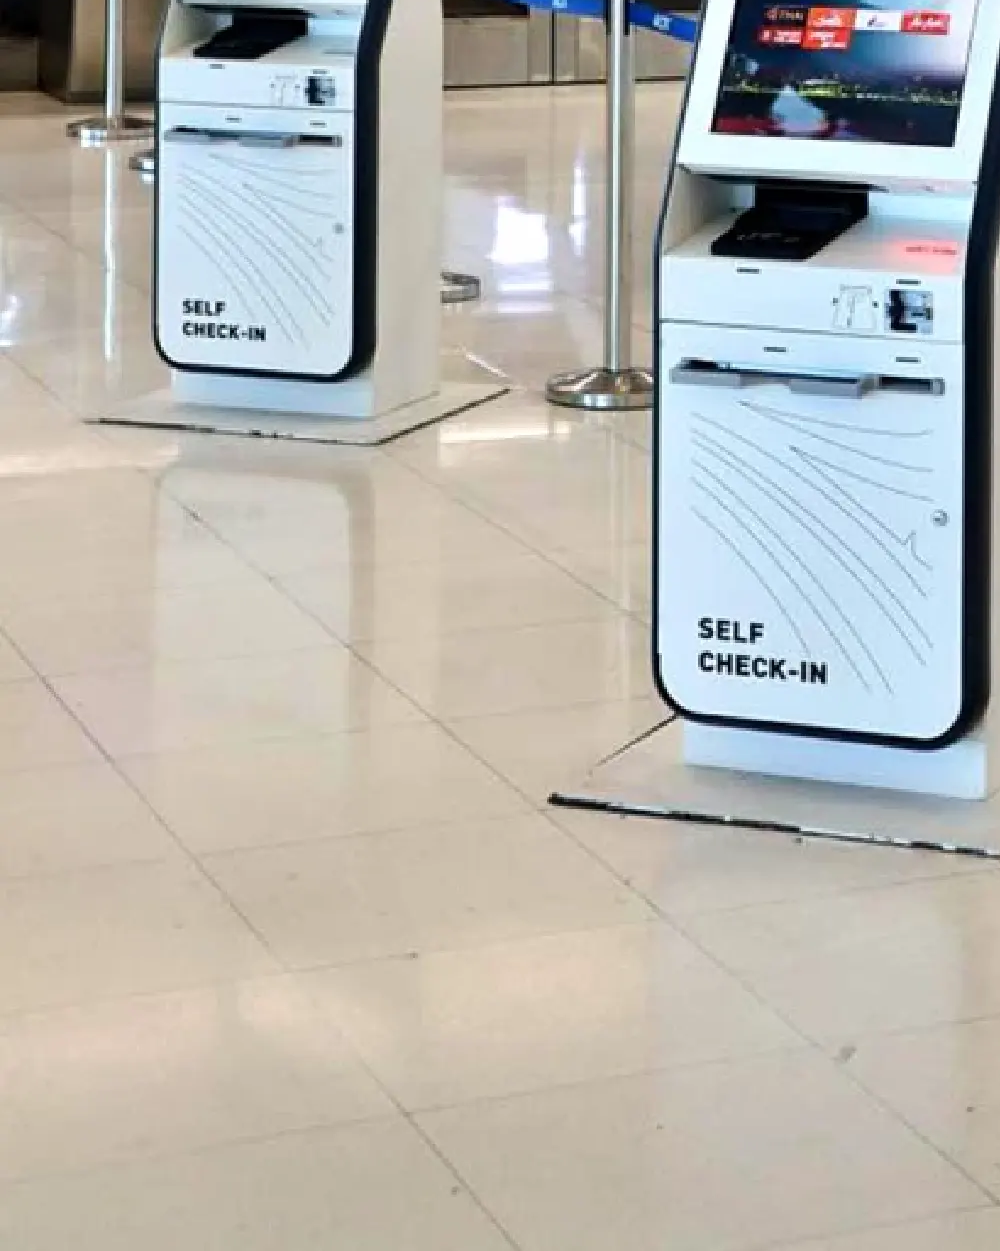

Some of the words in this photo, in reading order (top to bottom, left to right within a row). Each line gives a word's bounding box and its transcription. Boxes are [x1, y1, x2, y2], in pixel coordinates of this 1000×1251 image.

[182, 299, 226, 316] SELF
[182, 321, 267, 342] CHECK-IN
[698, 617, 764, 644] SELF
[698, 650, 829, 685] CHECK-IN
